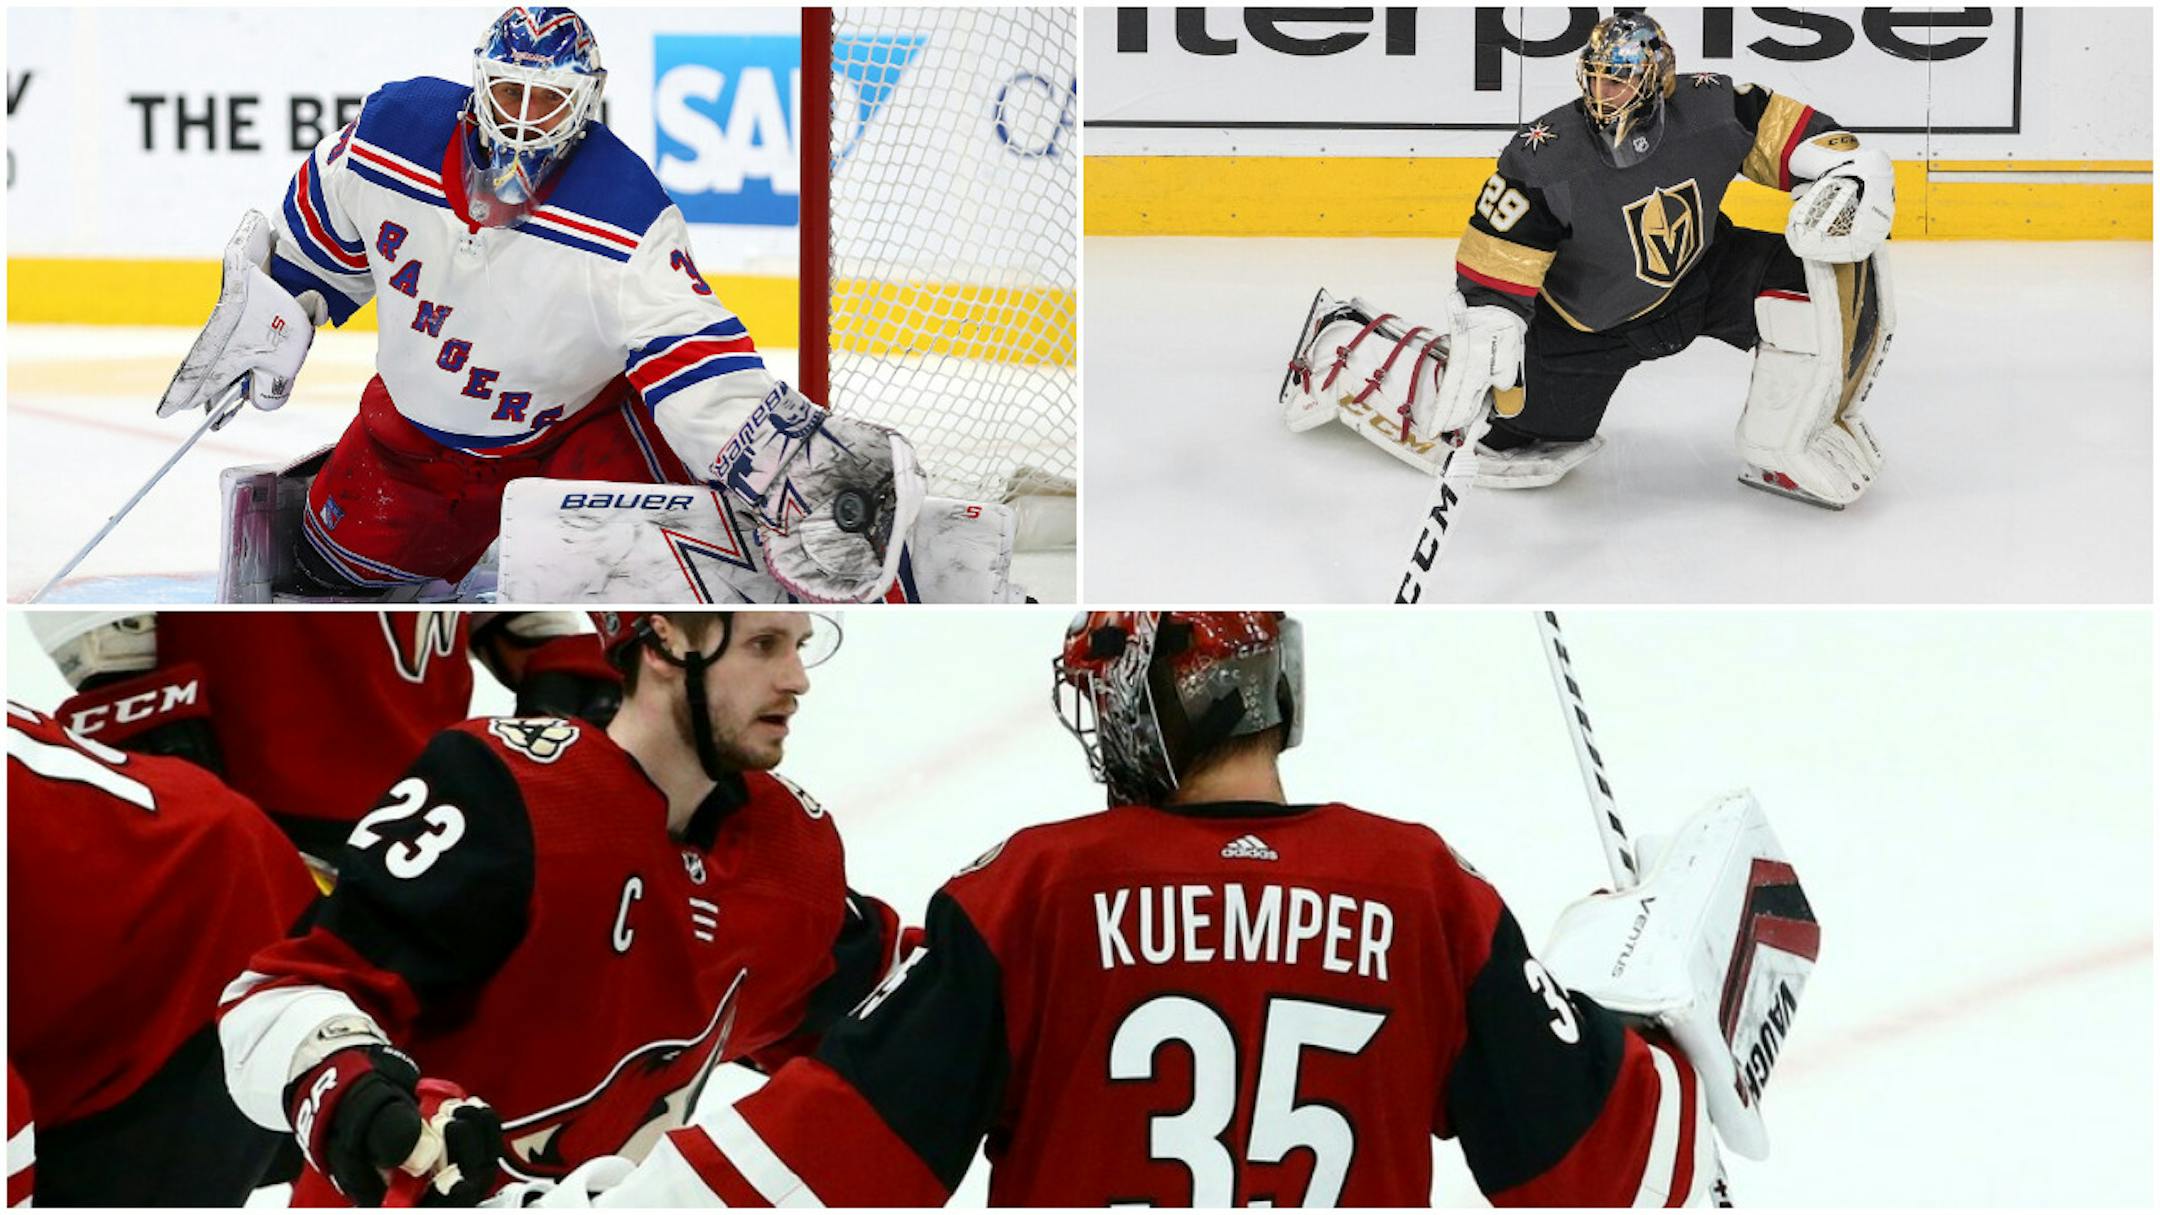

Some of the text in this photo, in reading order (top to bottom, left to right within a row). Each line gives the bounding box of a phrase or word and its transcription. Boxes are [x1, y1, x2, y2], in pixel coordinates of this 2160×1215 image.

[129, 95, 262, 152] THE
[1478, 174, 1531, 232] 29
[1393, 482, 1458, 604] CCM
[70, 679, 199, 737] CCM
[346, 777, 466, 879] 23
[1221, 848, 1279, 861] adidas
[613, 876, 643, 951] C
[1093, 882, 1394, 982] KUEMPER
[1611, 896, 1657, 978] VENTUS
[1524, 959, 1580, 1044] 3
[1109, 996, 1388, 1208] 35
